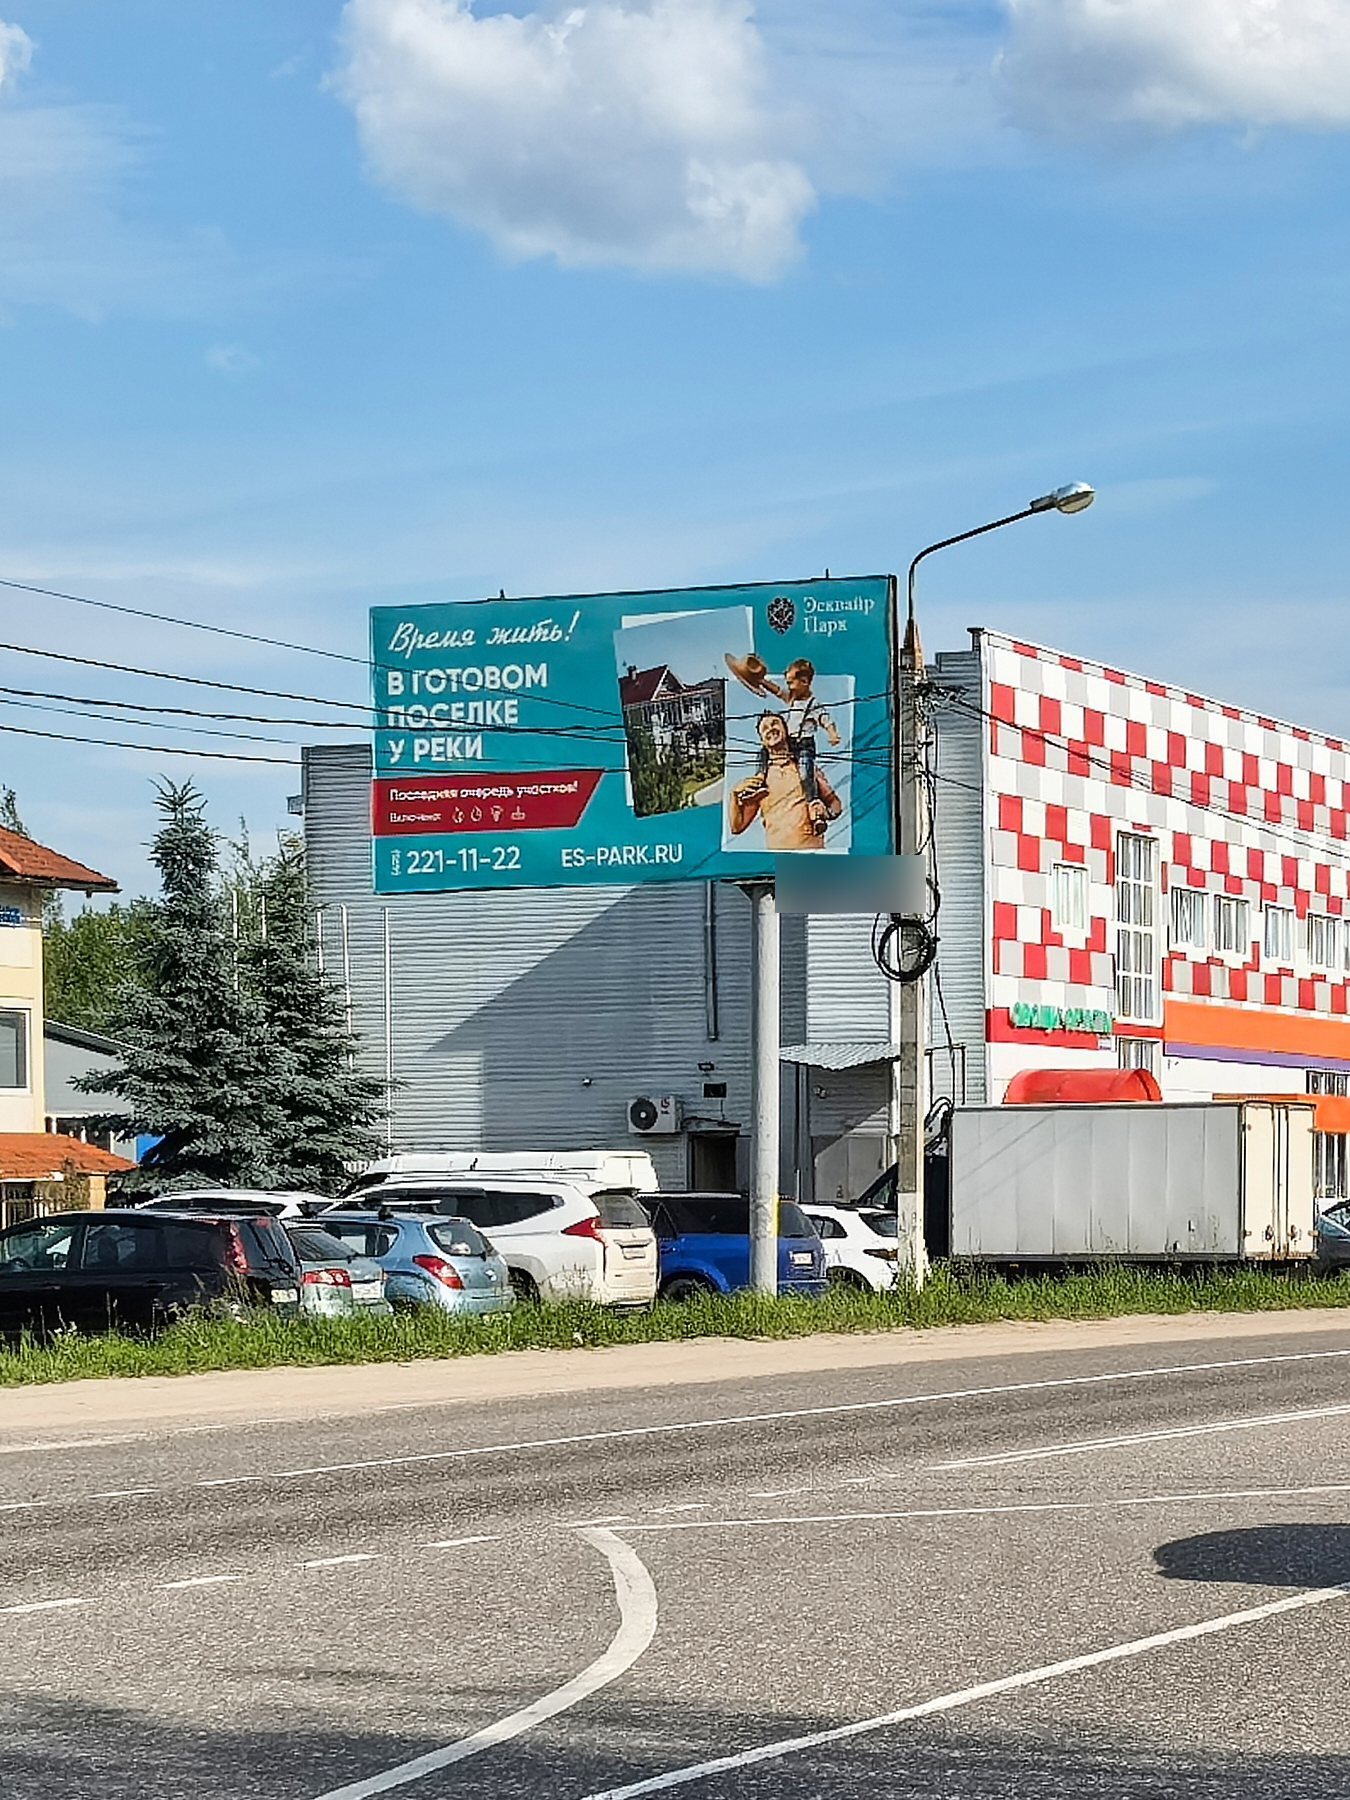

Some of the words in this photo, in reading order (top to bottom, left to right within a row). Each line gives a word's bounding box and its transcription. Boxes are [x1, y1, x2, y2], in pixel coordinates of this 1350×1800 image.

[803, 596, 875, 615] Эсквайр
[388, 622, 476, 659] Время
[486, 610, 580, 645] жить!
[803, 616, 848, 637] Парк
[388, 670, 404, 695] В
[412, 663, 548, 695] ГОТОВОМ
[388, 699, 518, 728] ПОСЕЛКЕ
[388, 739, 404, 764] У
[414, 734, 483, 762] РЕКИ
[407, 846, 521, 874] 221-11-22
[561, 844, 683, 868] ES-PARK.RU
